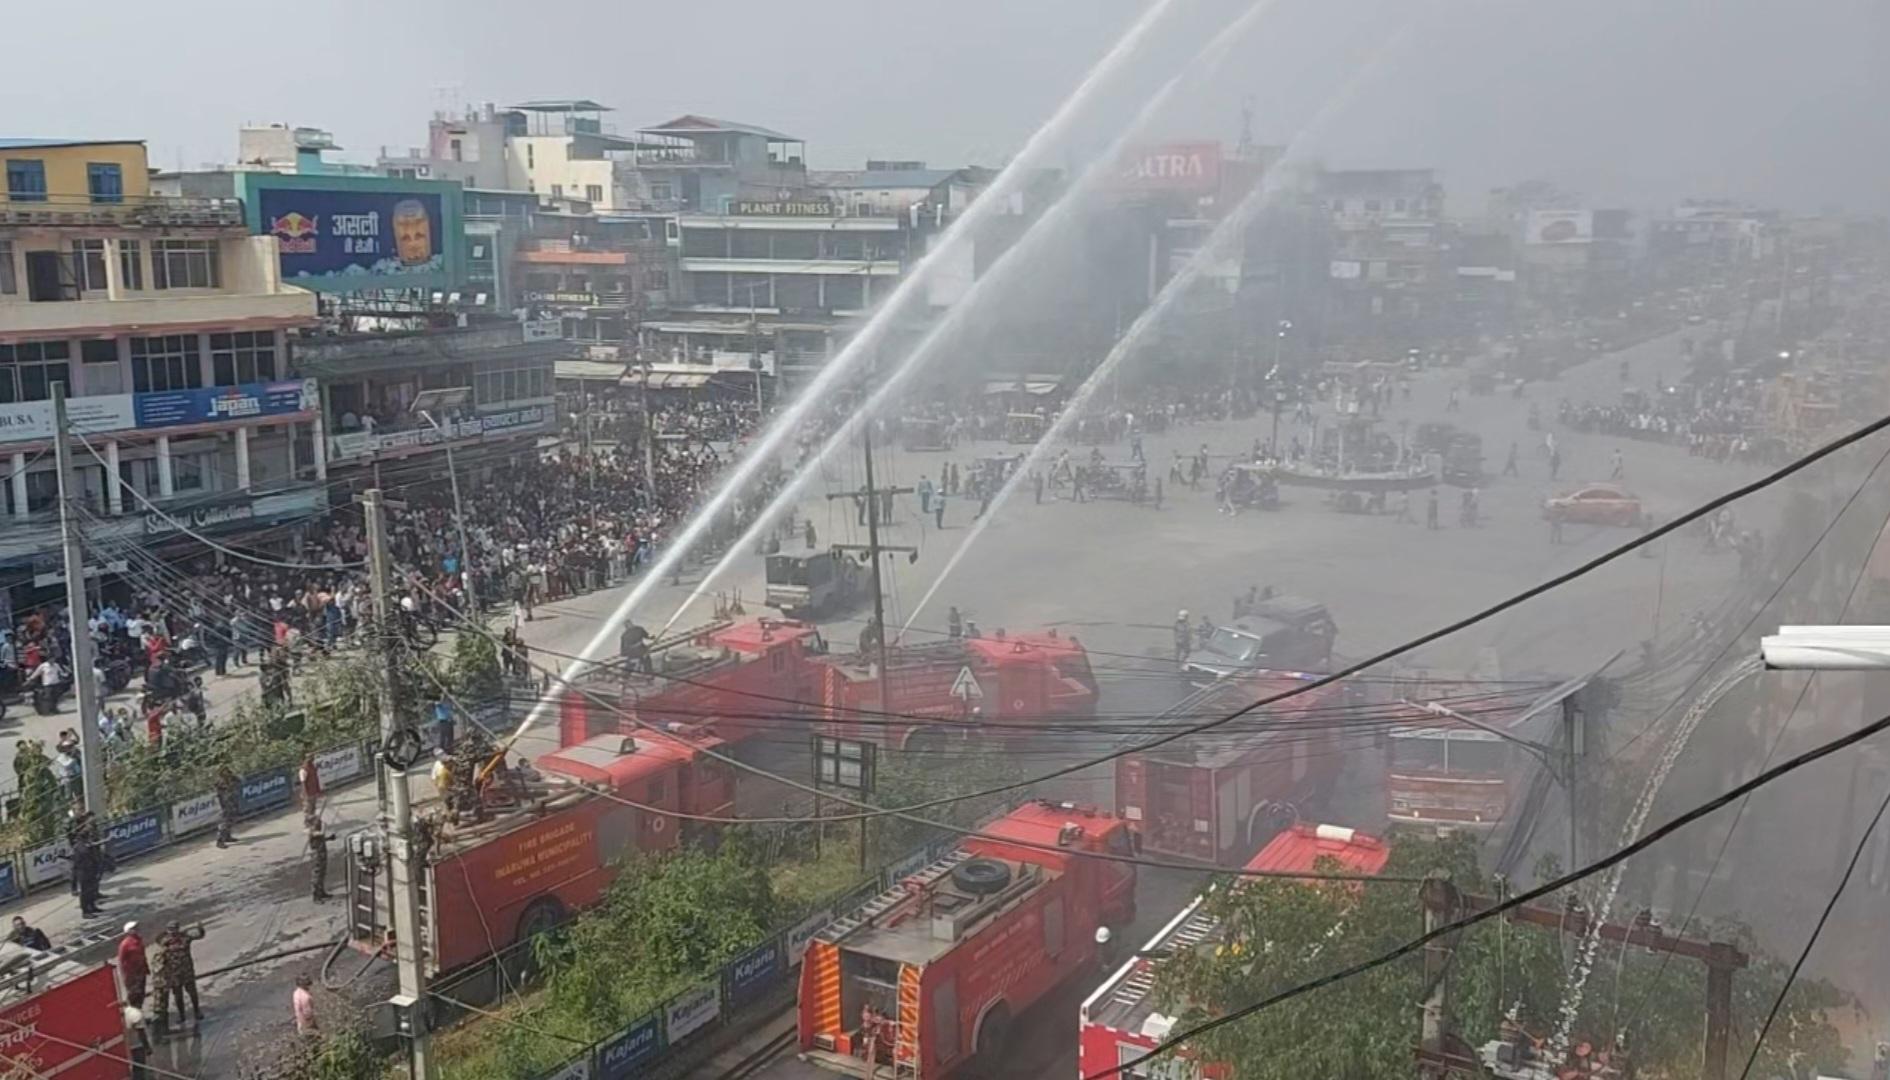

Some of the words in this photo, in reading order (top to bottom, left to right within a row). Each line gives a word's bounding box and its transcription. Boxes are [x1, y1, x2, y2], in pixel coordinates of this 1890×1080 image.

[741, 203, 781, 214] PLANET
[785, 203, 830, 215] FITNESS
[331, 211, 379, 236] असली
[207, 396, 261, 416] Japan
[193, 503, 252, 528] Collection
[242, 774, 286, 798] Kajaria
[178, 796, 216, 819] Kajari
[110, 817, 157, 839] Kajaria
[537, 831, 592, 861] MUNICIPALITY
[735, 949, 775, 981] Kajaria
[605, 1028, 654, 1065] Kajaria
